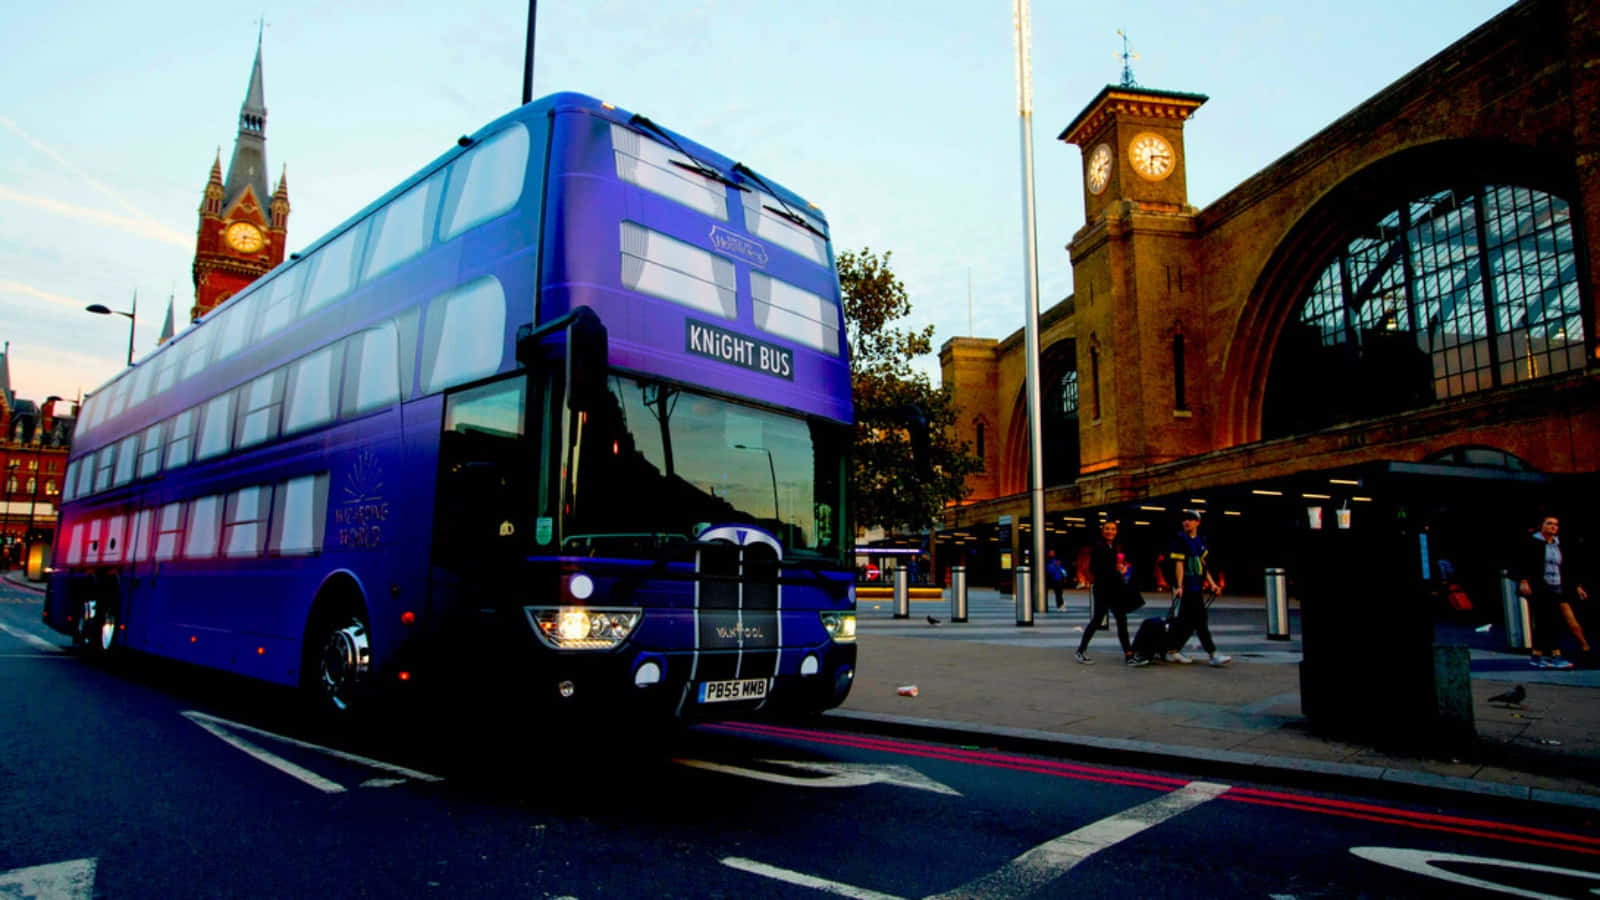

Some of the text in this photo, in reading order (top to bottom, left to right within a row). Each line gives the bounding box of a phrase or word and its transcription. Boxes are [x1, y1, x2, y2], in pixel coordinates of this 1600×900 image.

[760, 346, 790, 377] BUS
[707, 680, 765, 699] PB55 MMB
